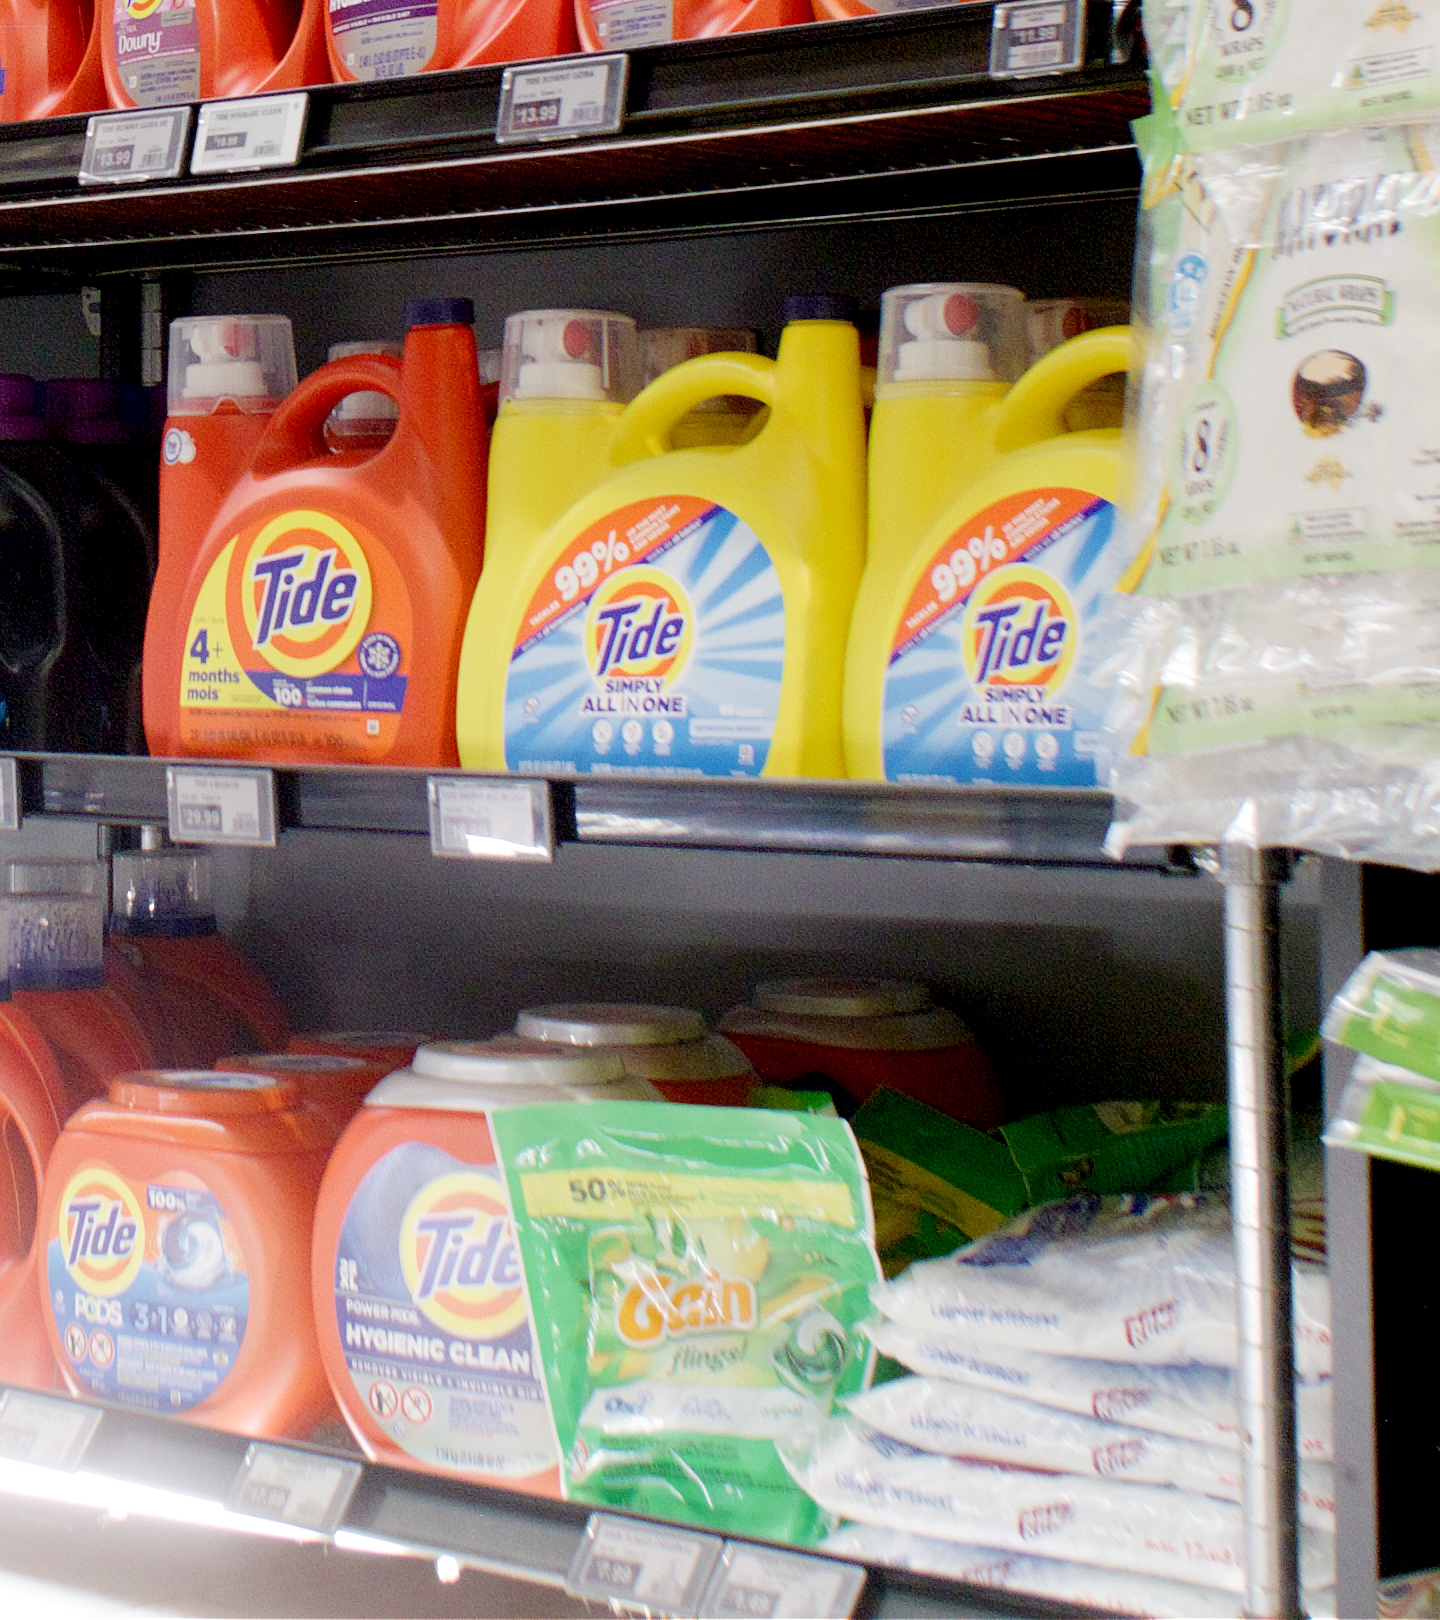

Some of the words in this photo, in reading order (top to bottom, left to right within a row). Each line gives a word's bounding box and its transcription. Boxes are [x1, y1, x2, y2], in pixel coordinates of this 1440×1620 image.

[118, 30, 163, 55] Downy
[553, 528, 631, 602] 99%
[930, 524, 1009, 603] 99%
[252, 547, 358, 649] Tide
[595, 596, 685, 677] Tide
[975, 599, 1068, 685] Tide
[188, 667, 240, 685] months
[603, 676, 664, 695] SIMPLY
[186, 684, 220, 701] mois
[581, 695, 620, 714] ALL
[642, 696, 685, 714] ONE
[985, 686, 1045, 703] SIMPLY
[961, 706, 997, 724] ALL
[1001, 707, 1021, 723] IN
[1024, 707, 1067, 725] ONE
[147, 1189, 186, 1211] 100%
[568, 1176, 626, 1202] 50%
[66, 1197, 137, 1272] Tide
[412, 1209, 523, 1302] Tide
[74, 1295, 122, 1328] PODS
[346, 1299, 388, 1321] POWER
[619, 1268, 753, 1343] Gain
[345, 1323, 446, 1364] HYGIENIC
[448, 1342, 532, 1375] CLEAN
